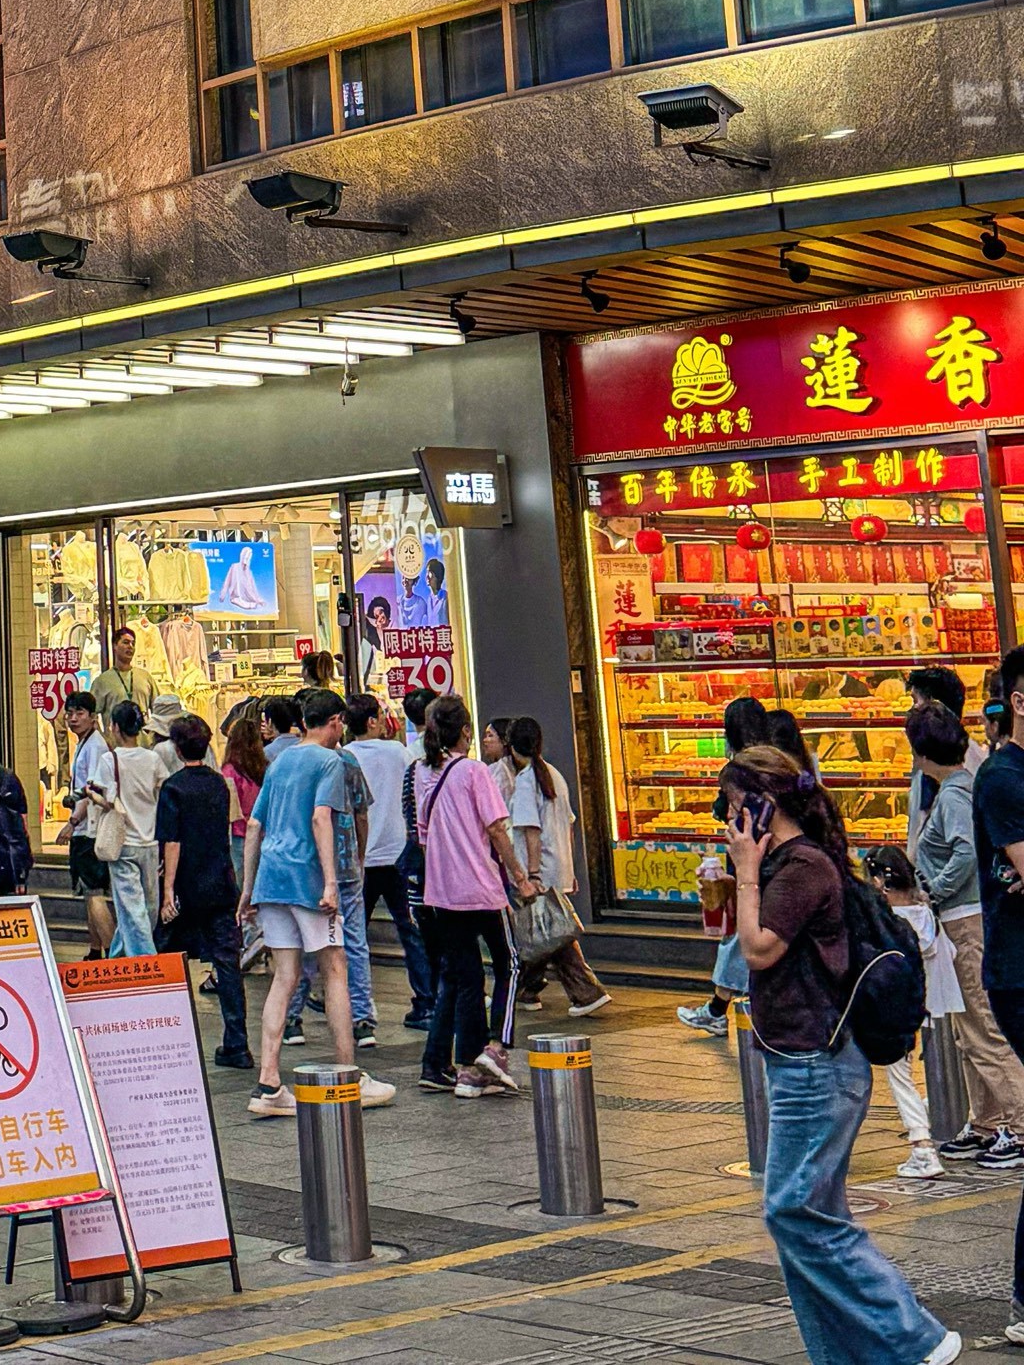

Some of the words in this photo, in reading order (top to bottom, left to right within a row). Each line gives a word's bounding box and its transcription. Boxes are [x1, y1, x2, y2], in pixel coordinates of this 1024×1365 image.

[663, 406, 753, 441] 中华老字号
[620, 460, 759, 505] 百年传承
[799, 448, 946, 495] 手工制作
[29, 649, 79, 671] 限时特惠
[384, 627, 453, 655] 限时特惠
[401, 656, 453, 697] 39
[41, 673, 79, 720] 39
